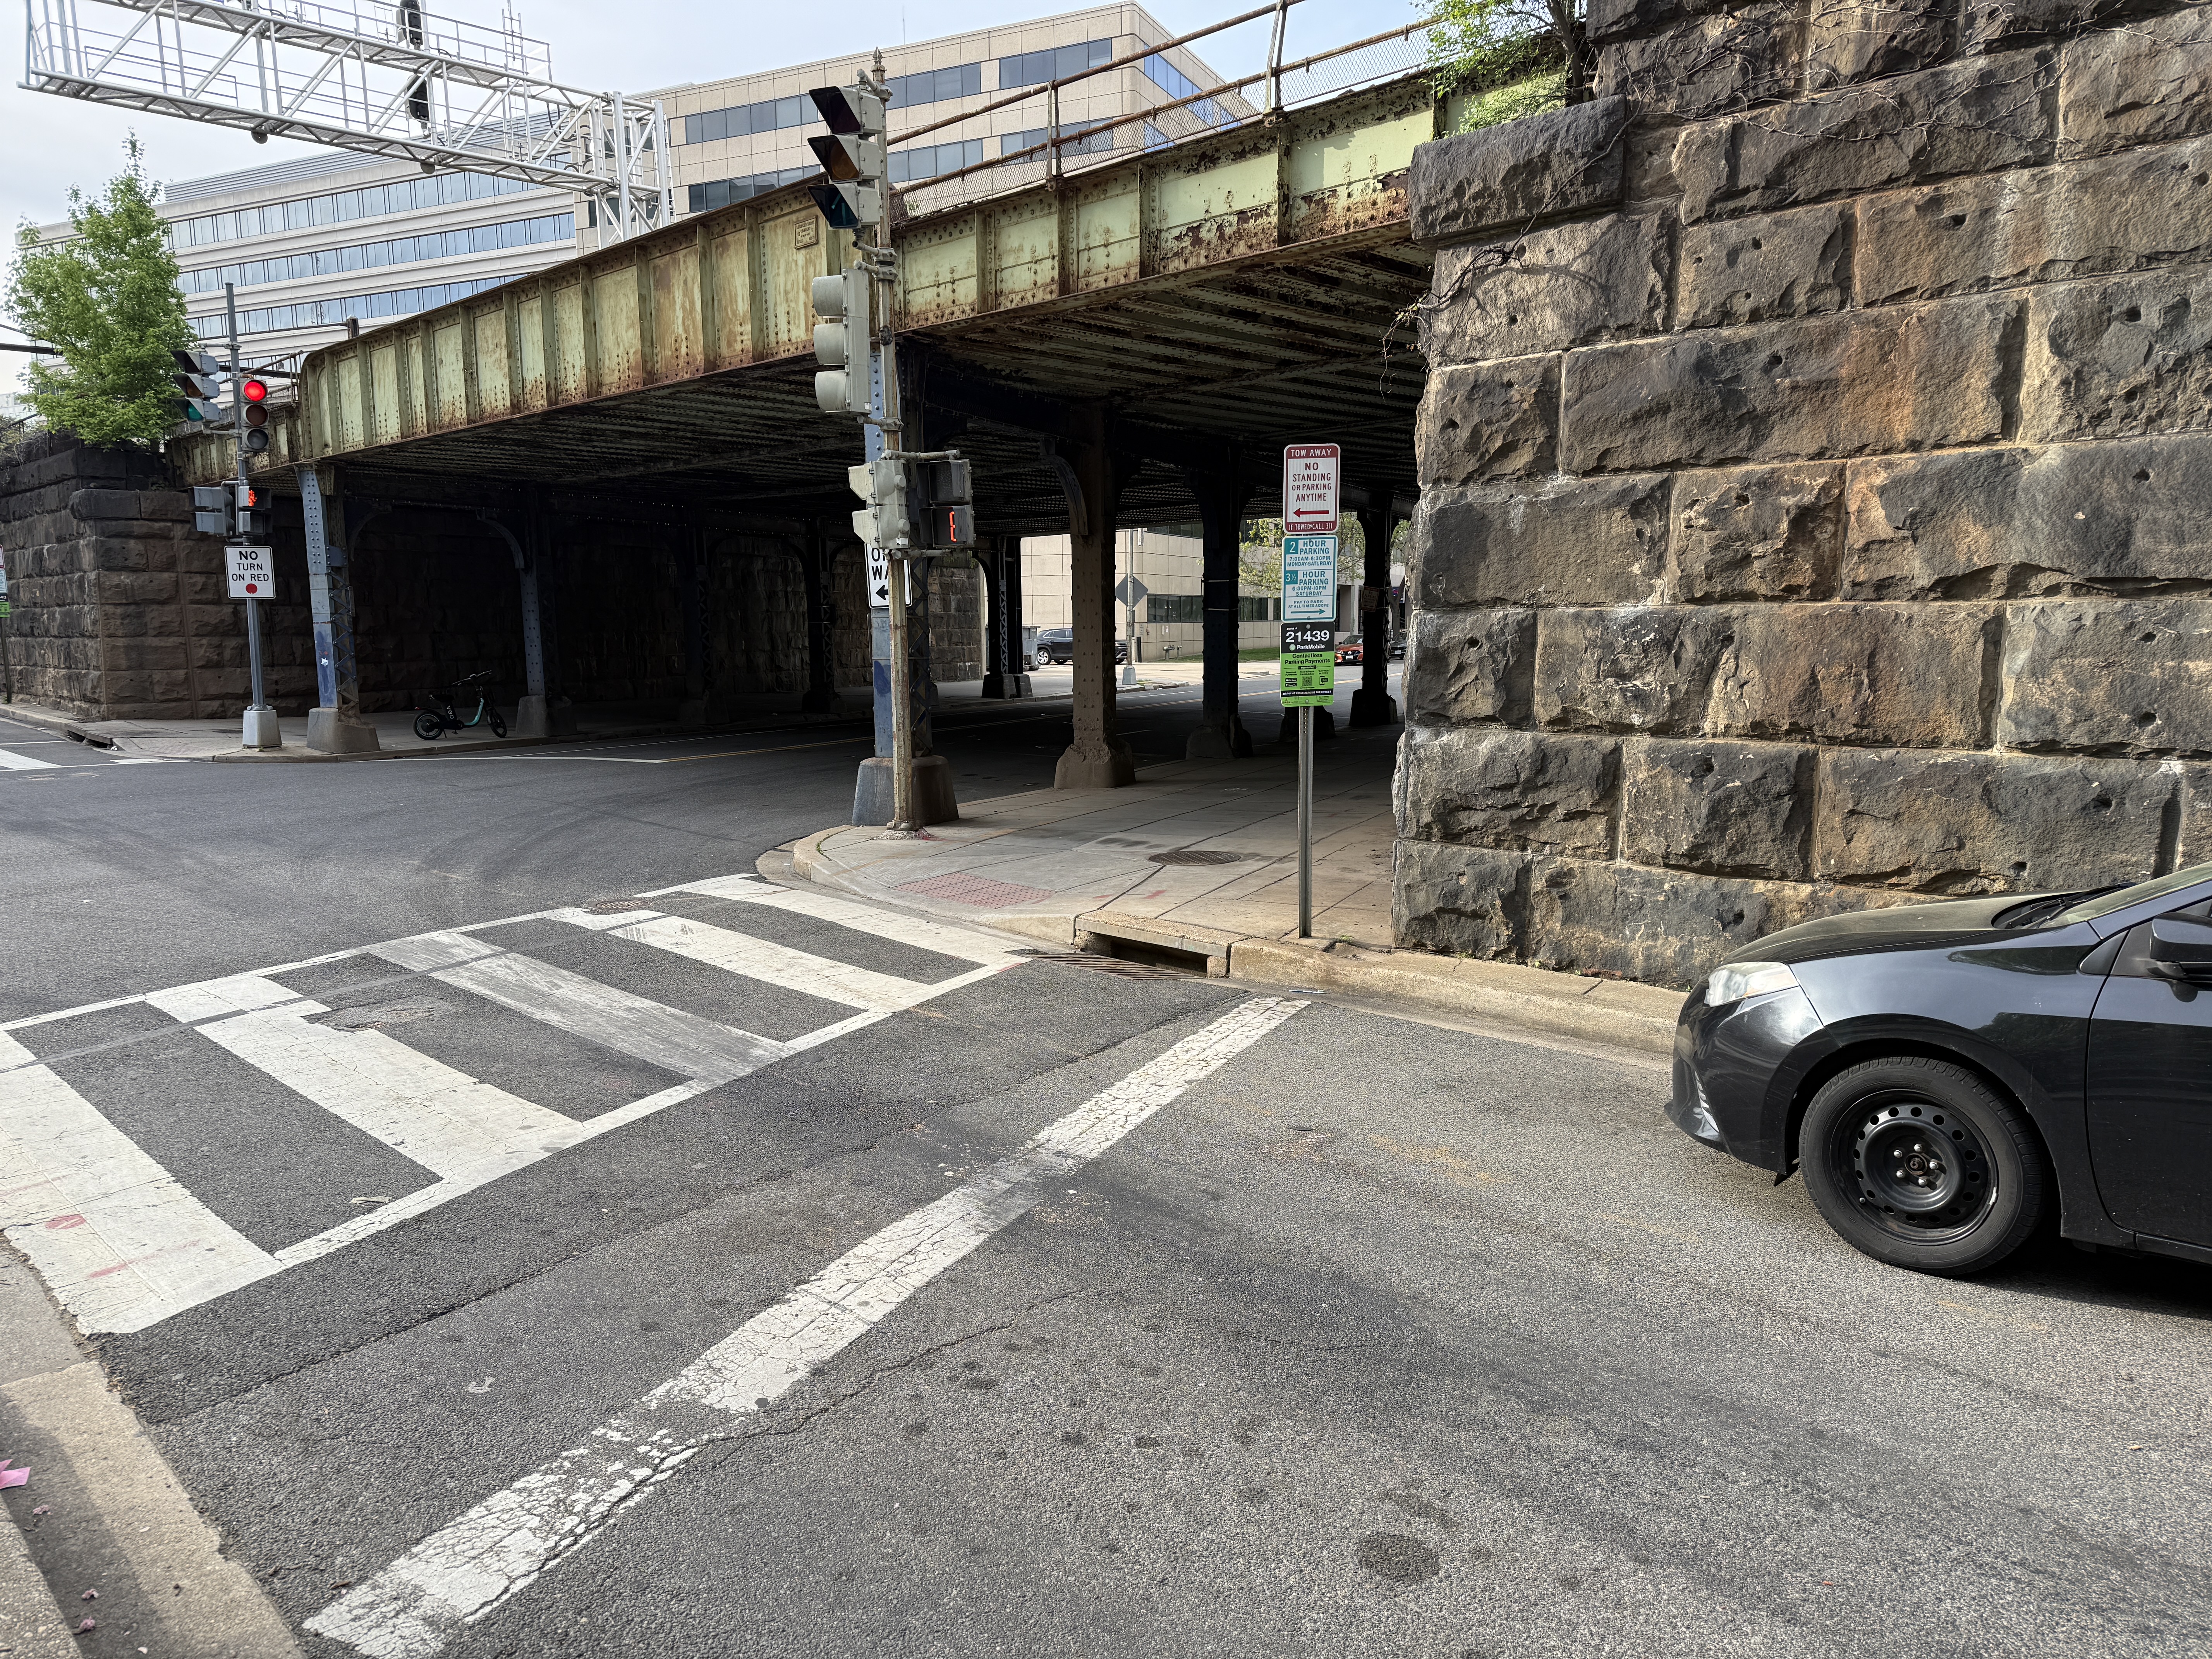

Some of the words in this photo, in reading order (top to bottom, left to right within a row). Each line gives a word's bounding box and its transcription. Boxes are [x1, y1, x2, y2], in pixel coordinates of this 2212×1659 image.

[1305, 462, 1319, 471] NO
[1293, 473, 1331, 482] STANDING
[1296, 493, 1327, 502] ANYTIME
[1290, 541, 1295, 553] 2
[239, 551, 258, 560] NO
[1286, 630, 1330, 642] 21439
